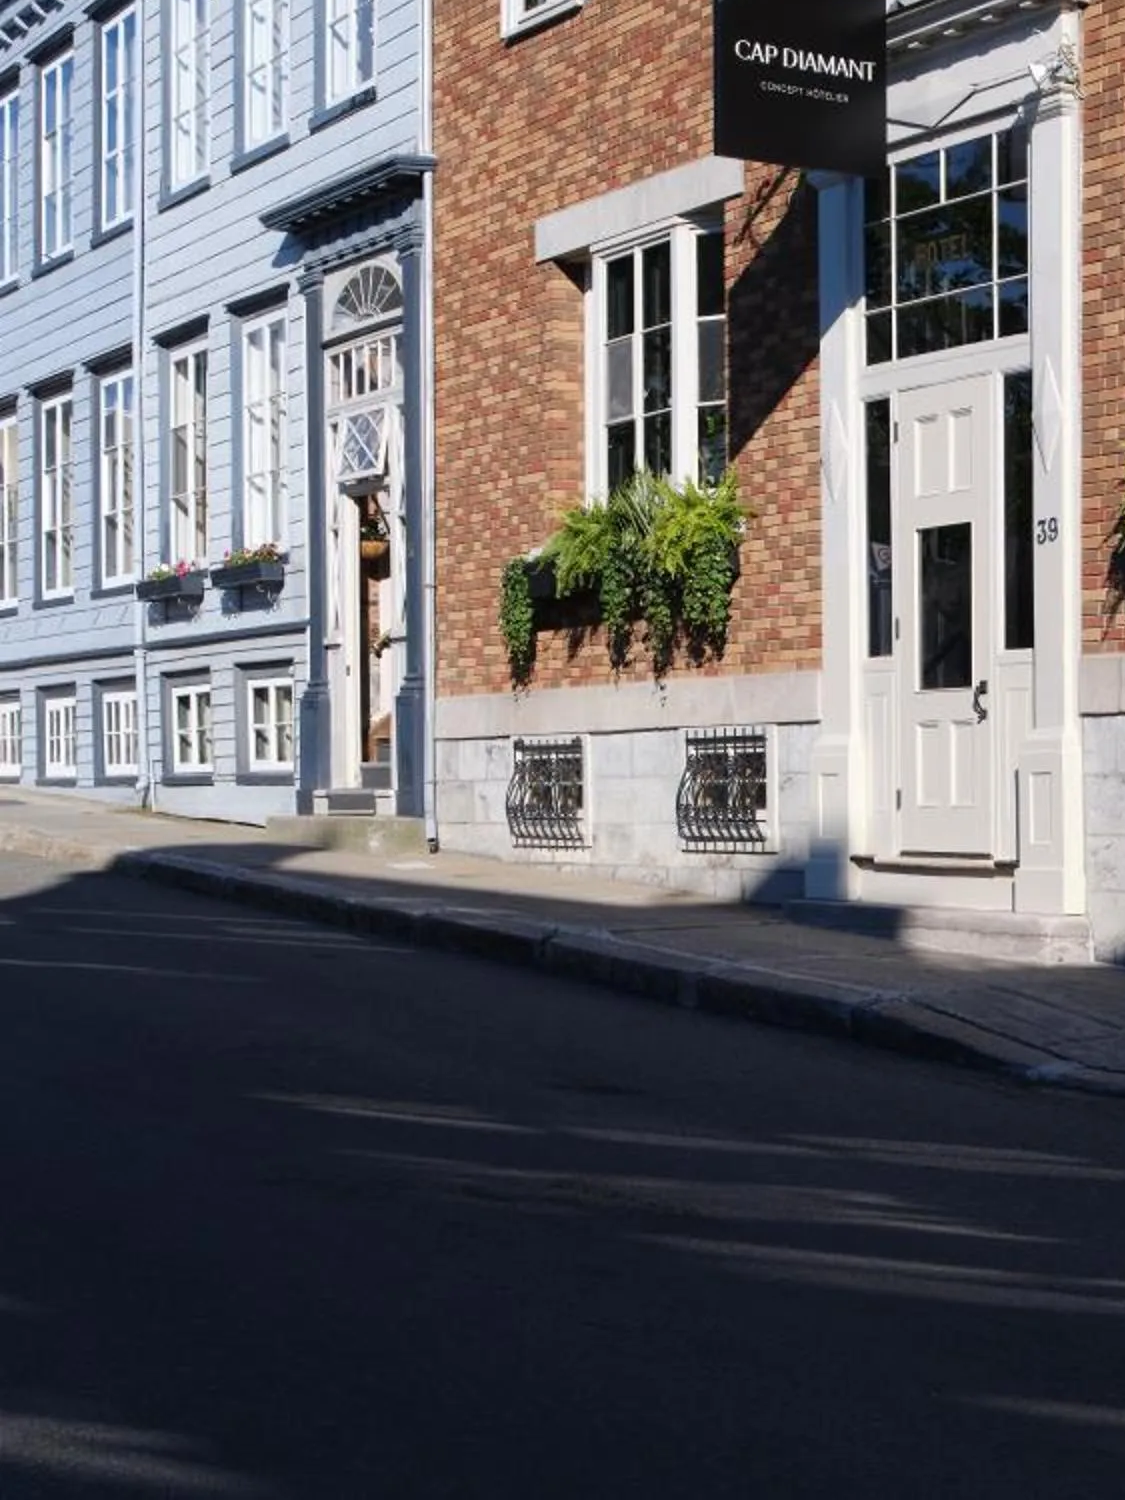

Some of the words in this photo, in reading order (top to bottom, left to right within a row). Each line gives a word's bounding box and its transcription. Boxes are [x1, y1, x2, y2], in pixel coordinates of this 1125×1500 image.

[735, 39, 778, 64] CAP
[783, 48, 876, 82] DIAMANT
[760, 81, 803, 96] CONCEPT
[1037, 517, 1058, 544] 39
